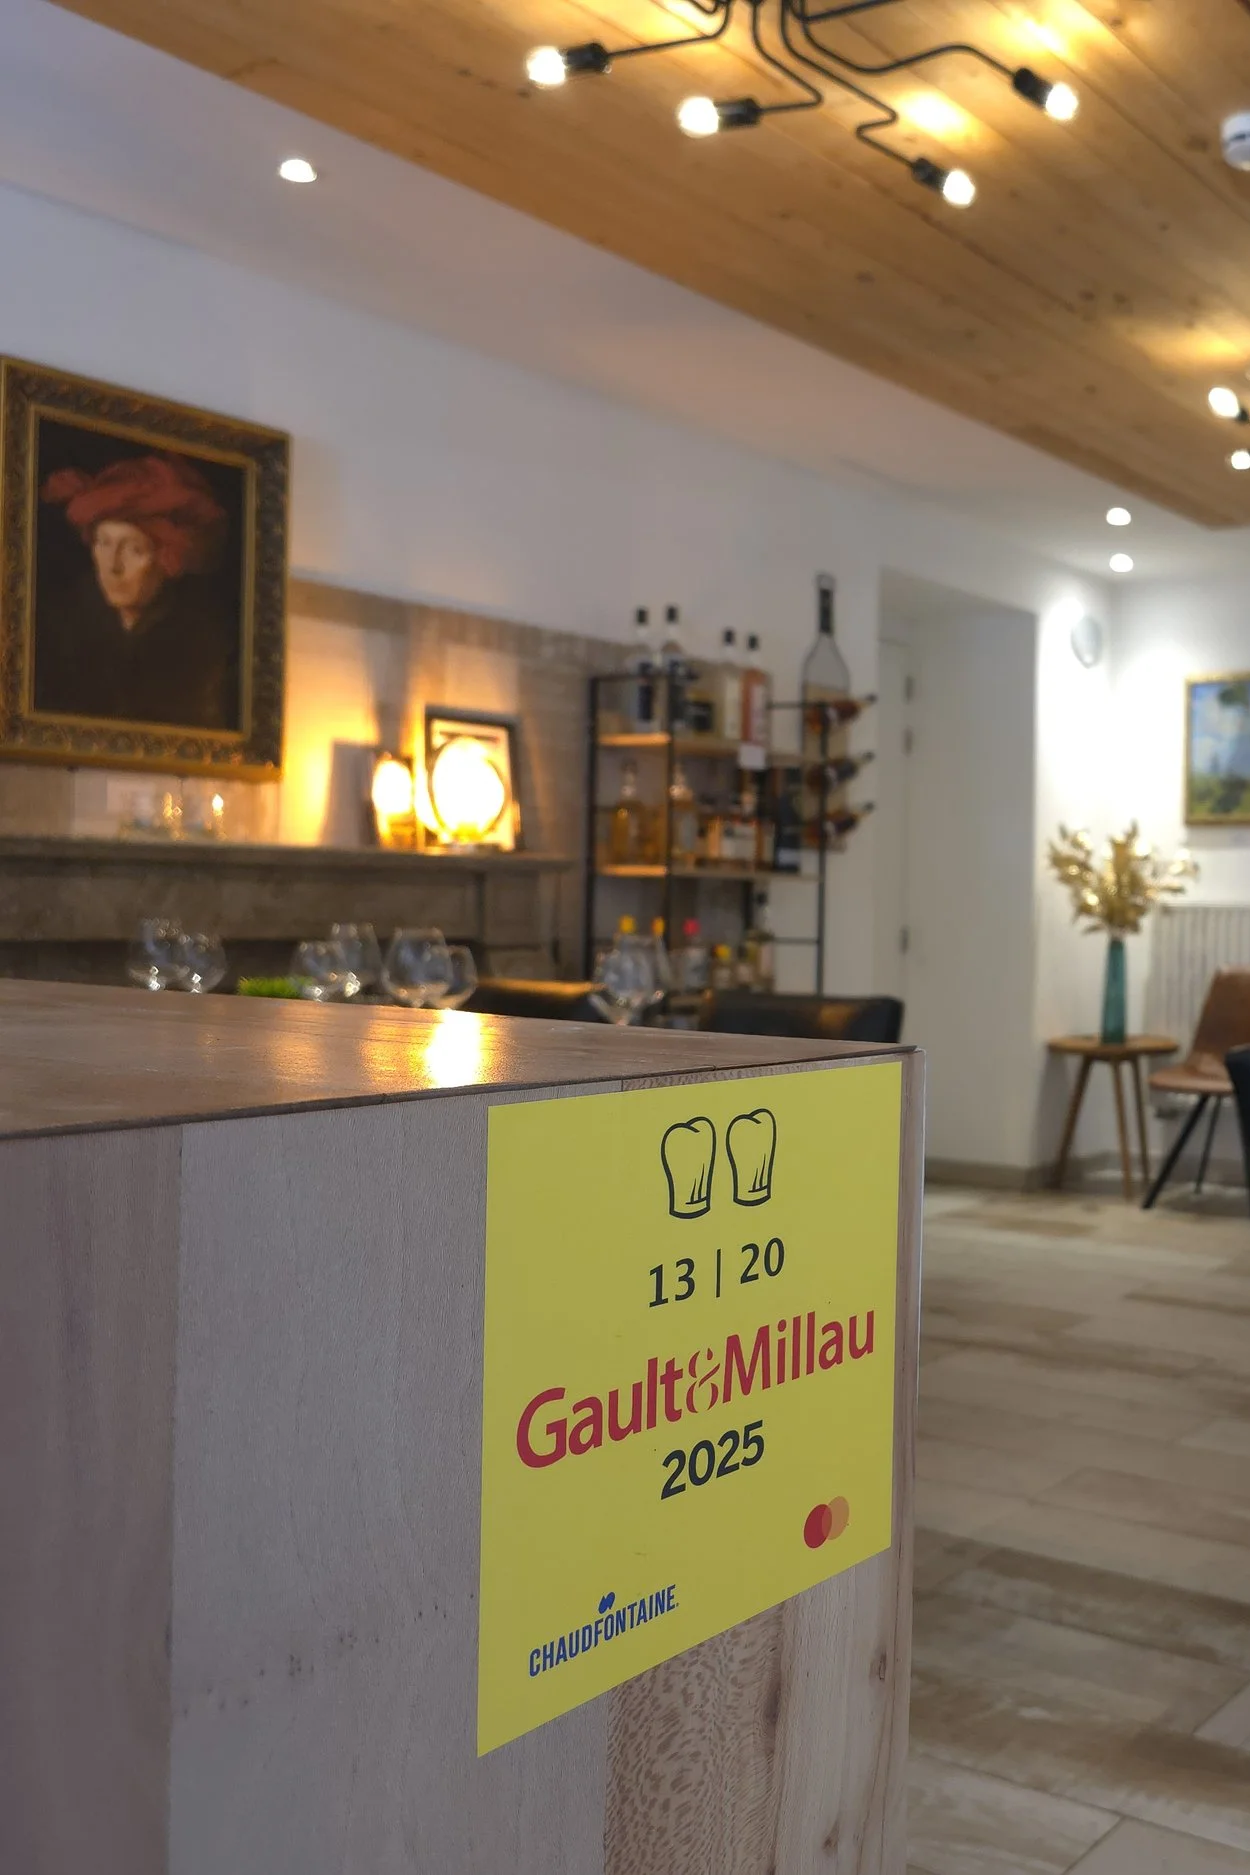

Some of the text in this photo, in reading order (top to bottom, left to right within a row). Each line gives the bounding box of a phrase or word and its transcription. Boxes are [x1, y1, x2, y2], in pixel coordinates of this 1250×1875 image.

[648, 1257, 697, 1308] 13
[739, 1237, 786, 1285] 20
[515, 1308, 876, 1470] Gault&Millau
[660, 1419, 766, 1501] 2025
